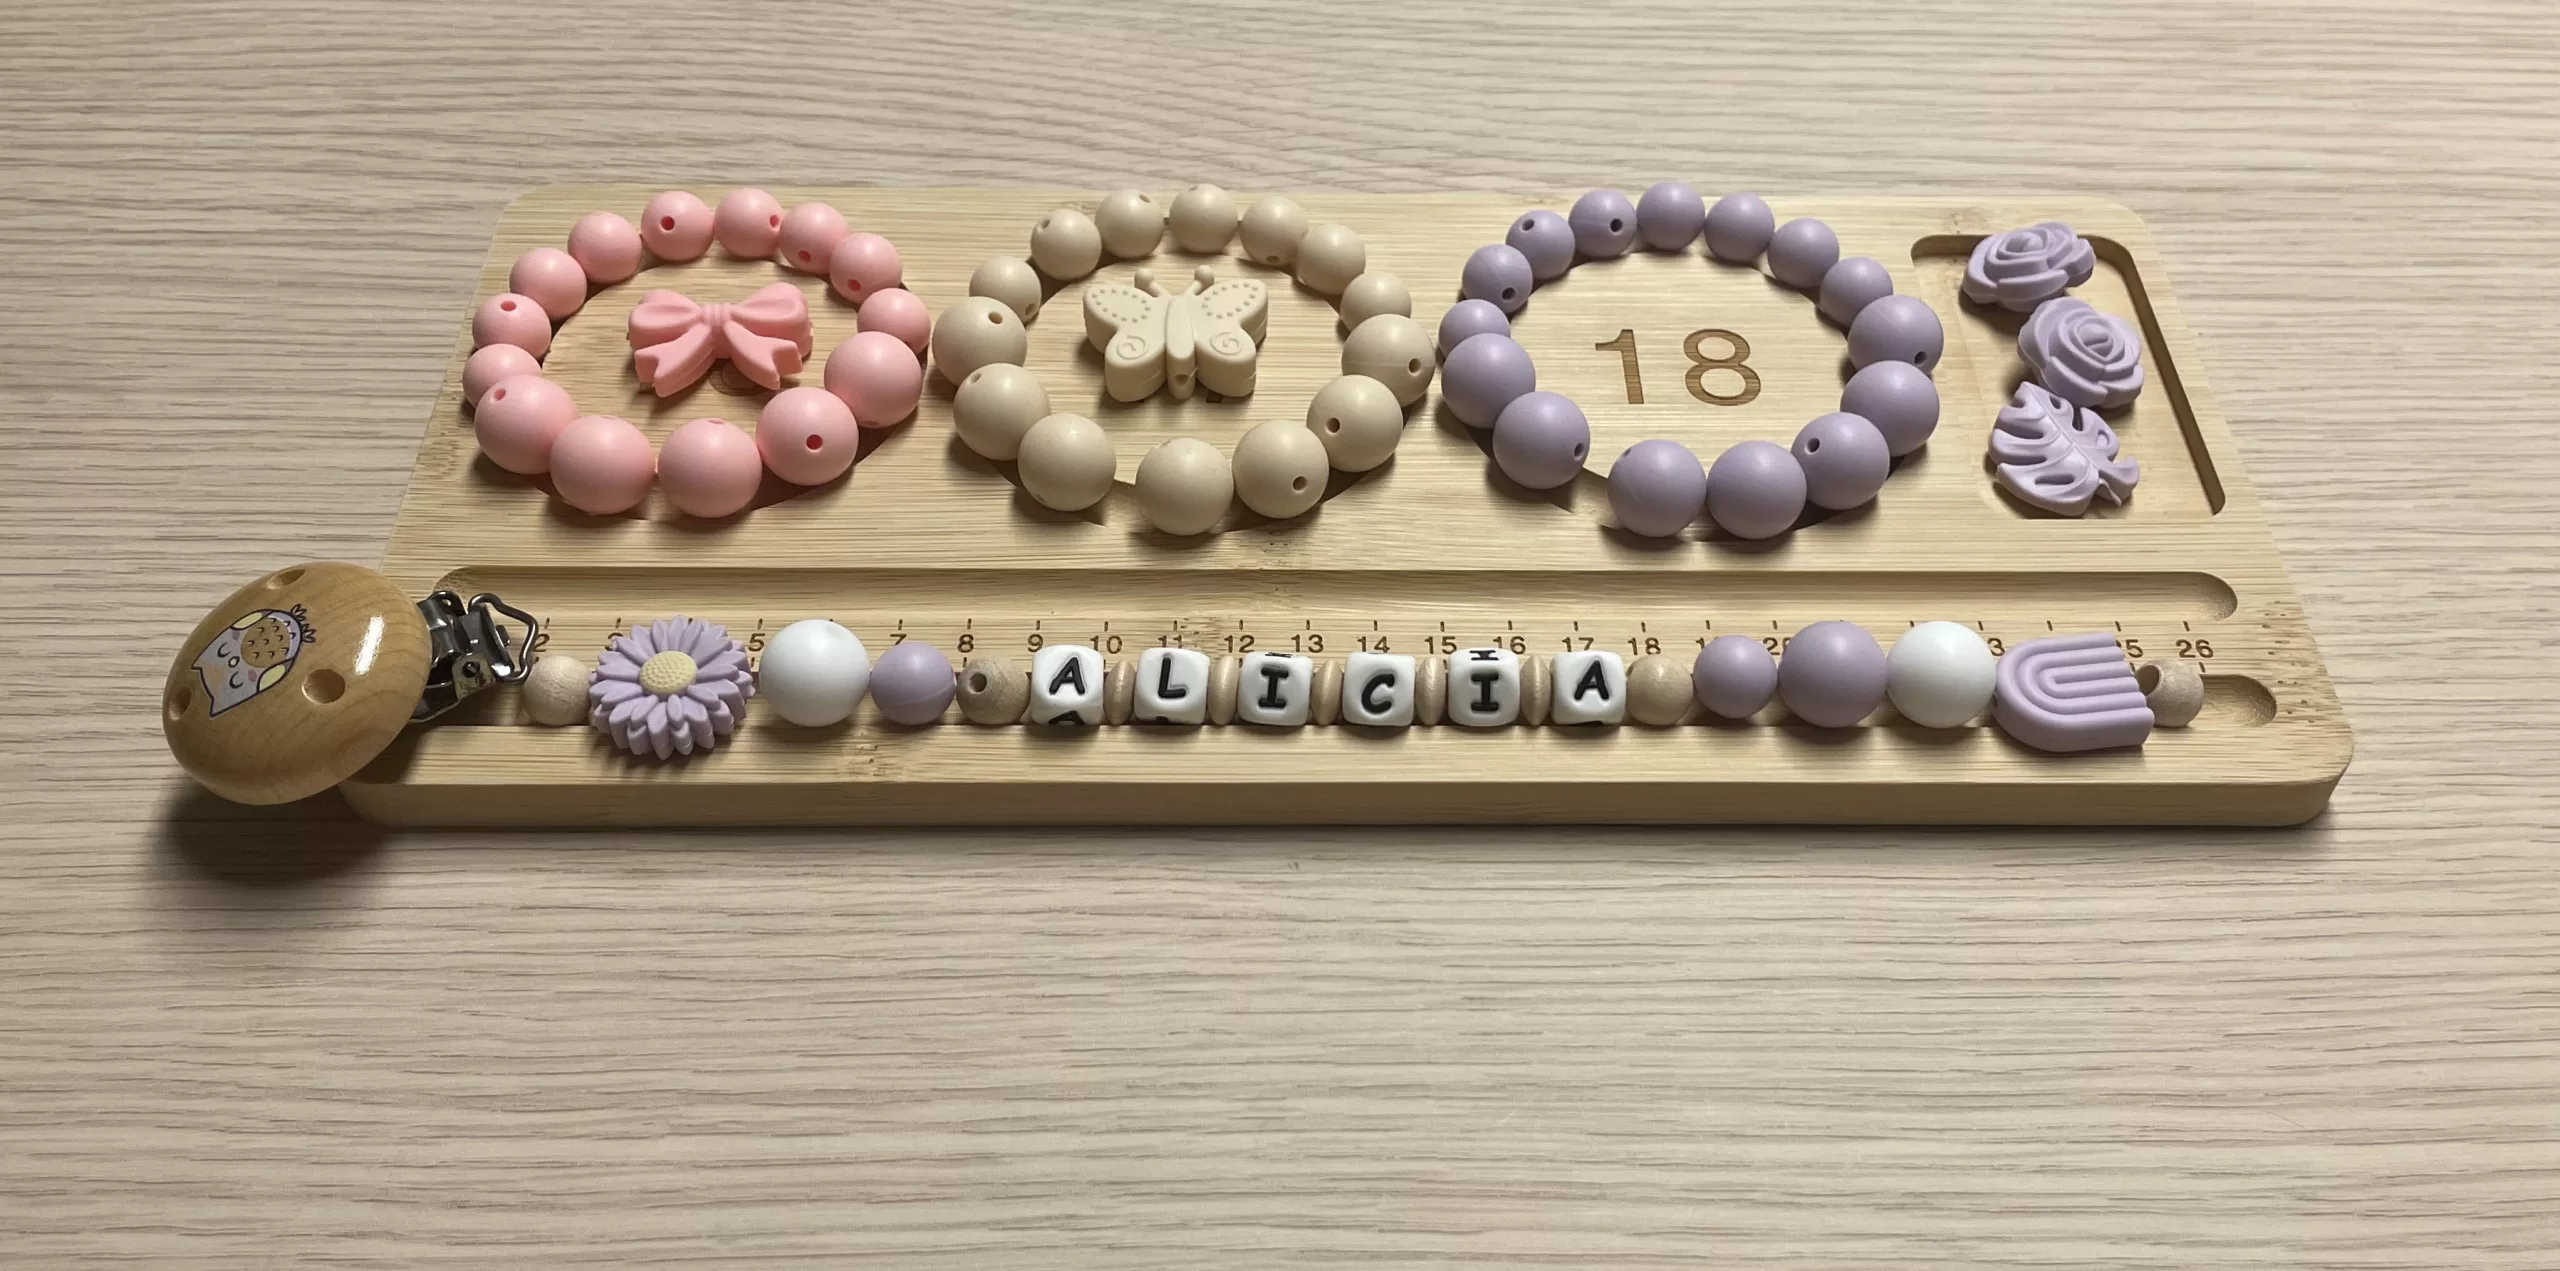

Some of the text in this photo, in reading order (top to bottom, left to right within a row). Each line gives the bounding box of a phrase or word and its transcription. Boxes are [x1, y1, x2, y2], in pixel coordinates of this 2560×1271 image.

[1595, 329, 1761, 406] 18
[533, 633, 550, 652] 2
[748, 633, 766, 652] 5
[889, 633, 907, 645] 7
[957, 633, 975, 653] 8
[1027, 633, 1044, 653] 9
[1090, 635, 1123, 654] 10
[1158, 635, 1183, 649] 11
[1224, 635, 1255, 653] 12
[1291, 634, 1324, 653] 13
[1357, 636, 1390, 653] 14
[1424, 636, 1457, 655] 15
[1493, 636, 1526, 655] 16
[1562, 637, 1594, 652] 17
[1627, 637, 1662, 655] 18
[2175, 639, 2214, 658] 26
